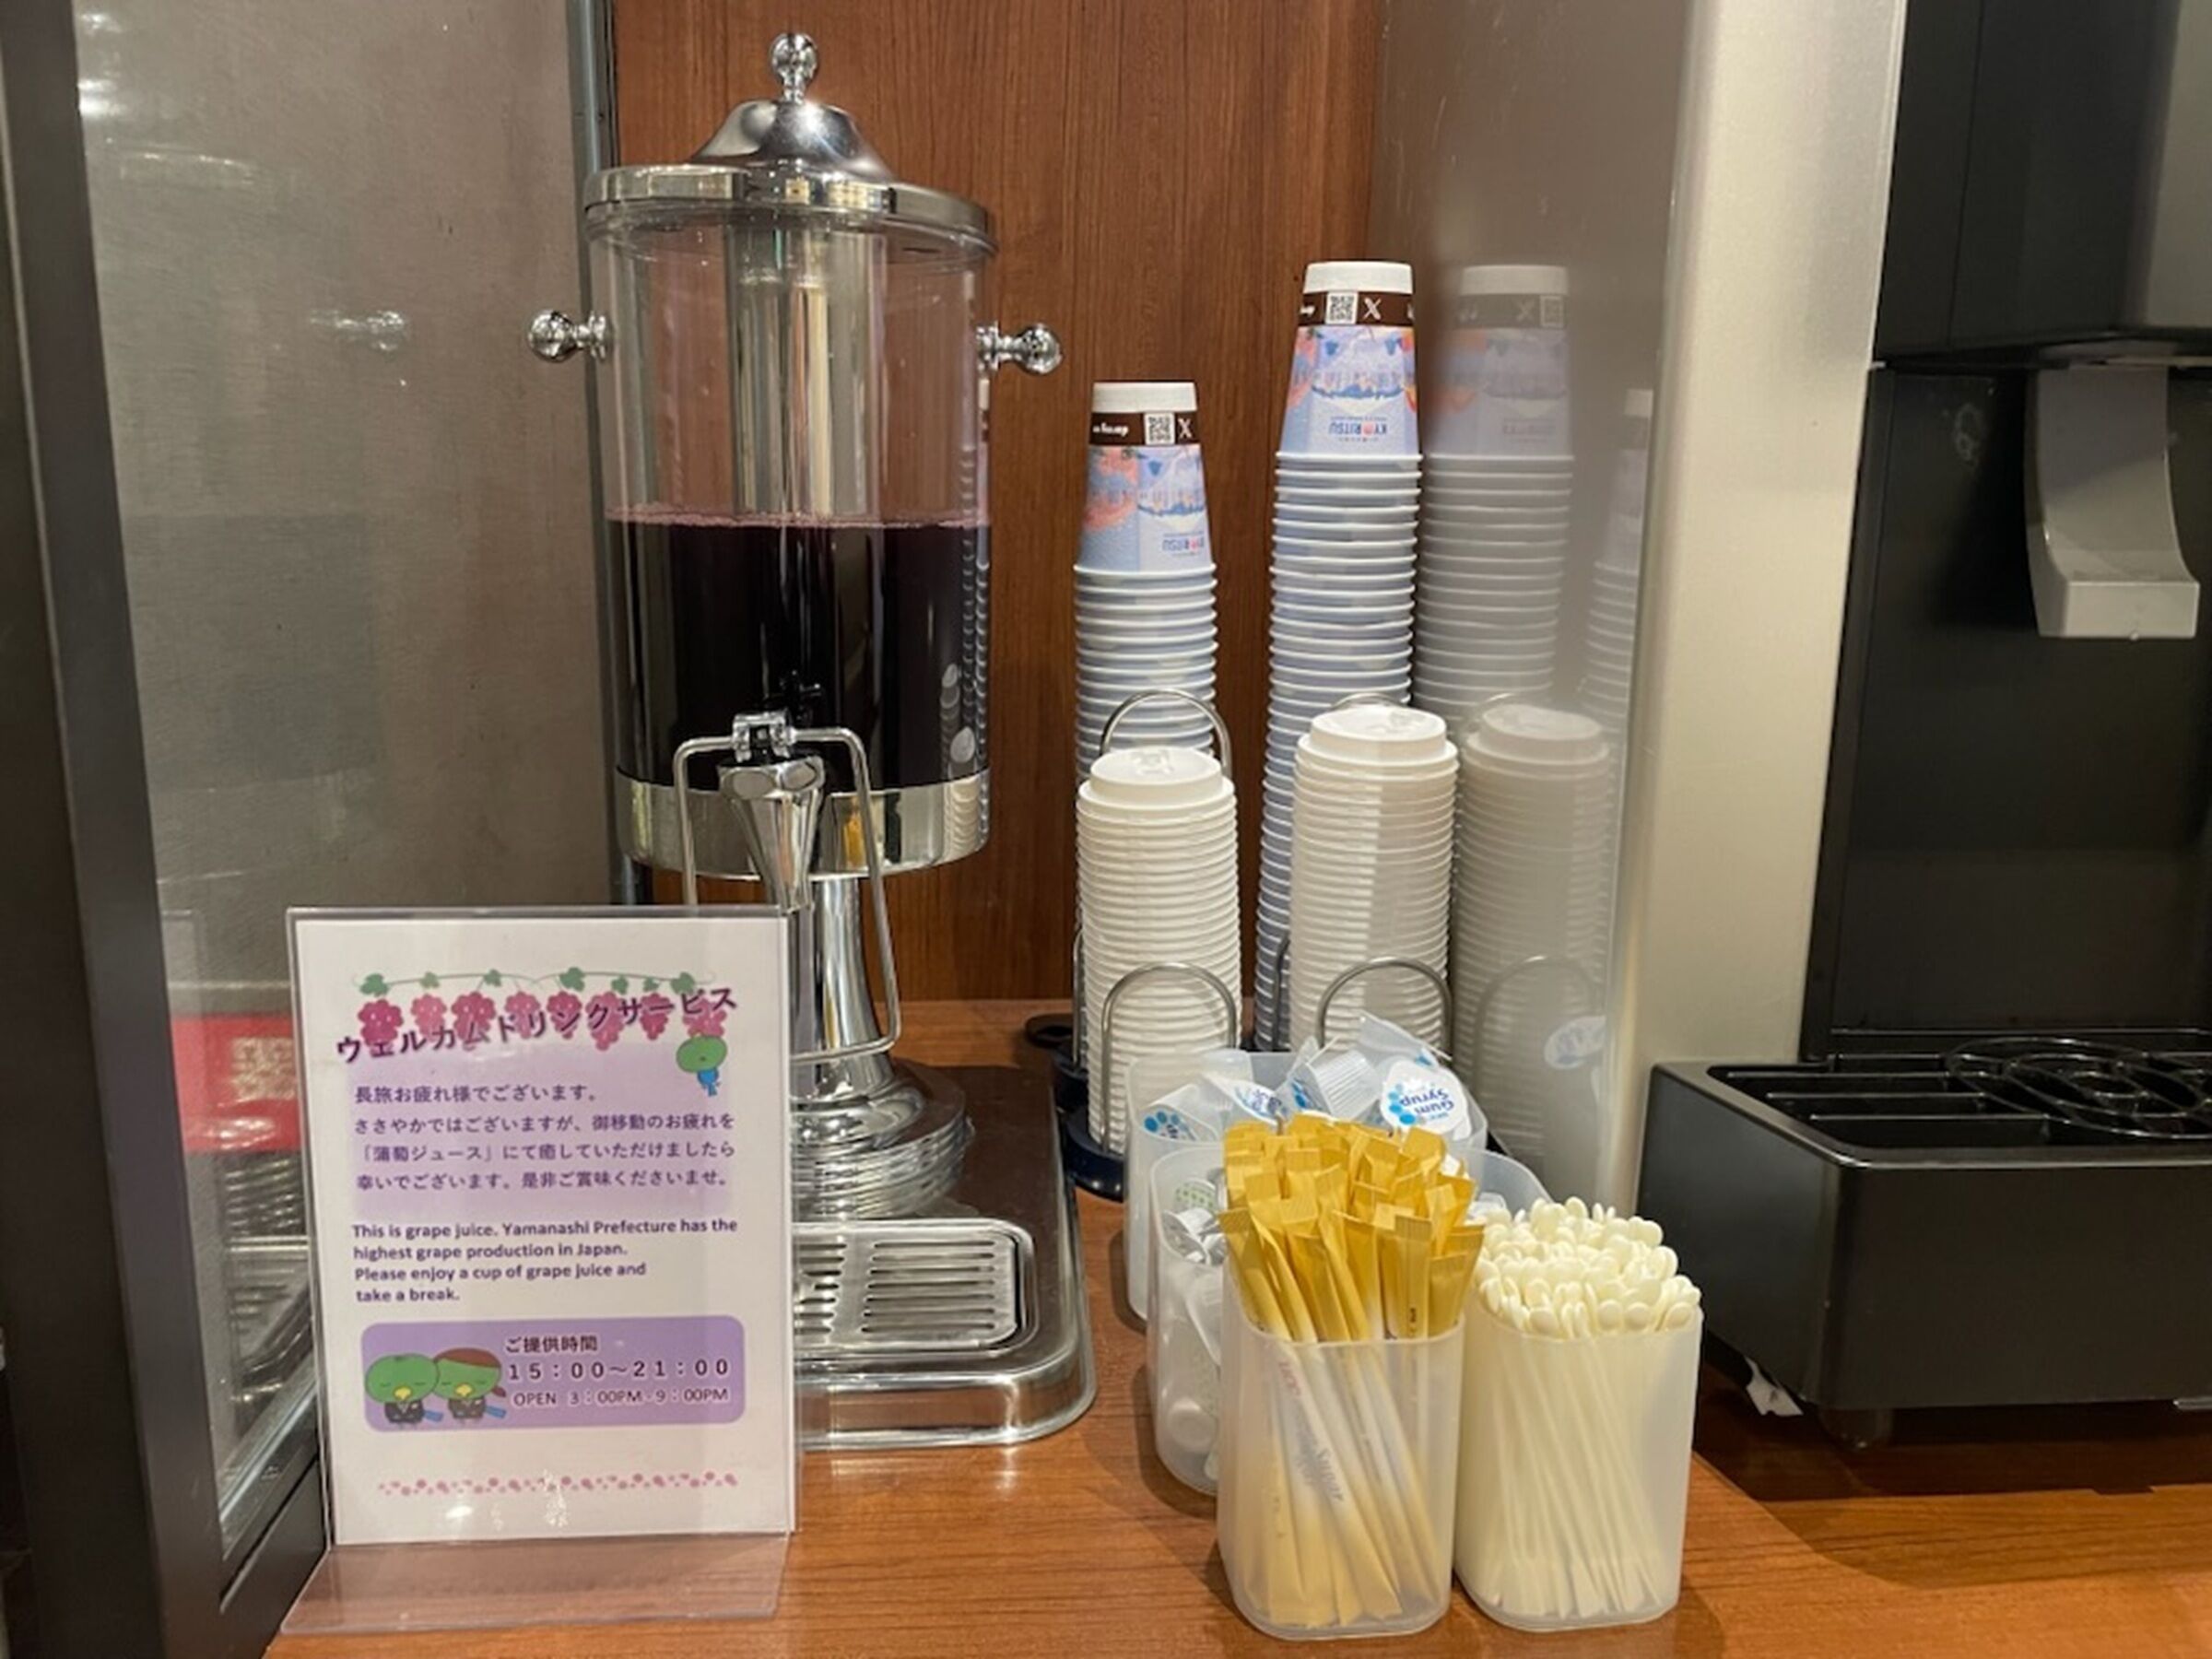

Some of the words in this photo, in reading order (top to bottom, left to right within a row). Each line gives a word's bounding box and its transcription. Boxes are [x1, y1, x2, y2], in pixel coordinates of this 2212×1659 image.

[336, 988, 736, 1064] ウェルカムドリンクサービス
[355, 1085, 596, 1105] 長旅お疲れ様でございます。
[1399, 1088, 1450, 1108] Syrup
[1414, 1100, 1455, 1115] Gum
[355, 1113, 735, 1135] ささやかではございますが、御移動のお疲れを
[357, 1169, 727, 1191] 幸いでございます。是非ご賞味くださいませ。
[352, 1224, 385, 1239] This
[389, 1223, 402, 1238] is
[406, 1226, 452, 1241] grape
[454, 1223, 499, 1240] juice.
[502, 1221, 590, 1236] Yamanashi
[594, 1219, 677, 1234] Prefecture
[680, 1218, 708, 1232] has
[712, 1218, 738, 1231] the
[353, 1246, 412, 1263] highest
[416, 1247, 462, 1262] grape
[466, 1243, 555, 1261] production
[559, 1242, 573, 1256] in
[577, 1243, 628, 1258] Japan.
[355, 1267, 406, 1281] Please
[410, 1266, 455, 1282] enjoy
[459, 1269, 468, 1279] a
[473, 1268, 502, 1281] cup
[505, 1265, 522, 1277] of
[526, 1265, 571, 1281] grape
[575, 1263, 613, 1279] juice
[617, 1262, 647, 1277] and
[356, 1288, 392, 1302] take
[395, 1291, 406, 1301] a
[409, 1288, 460, 1301] break.
[506, 1335, 599, 1354] ご提供時間
[513, 1392, 557, 1406] OPEN
